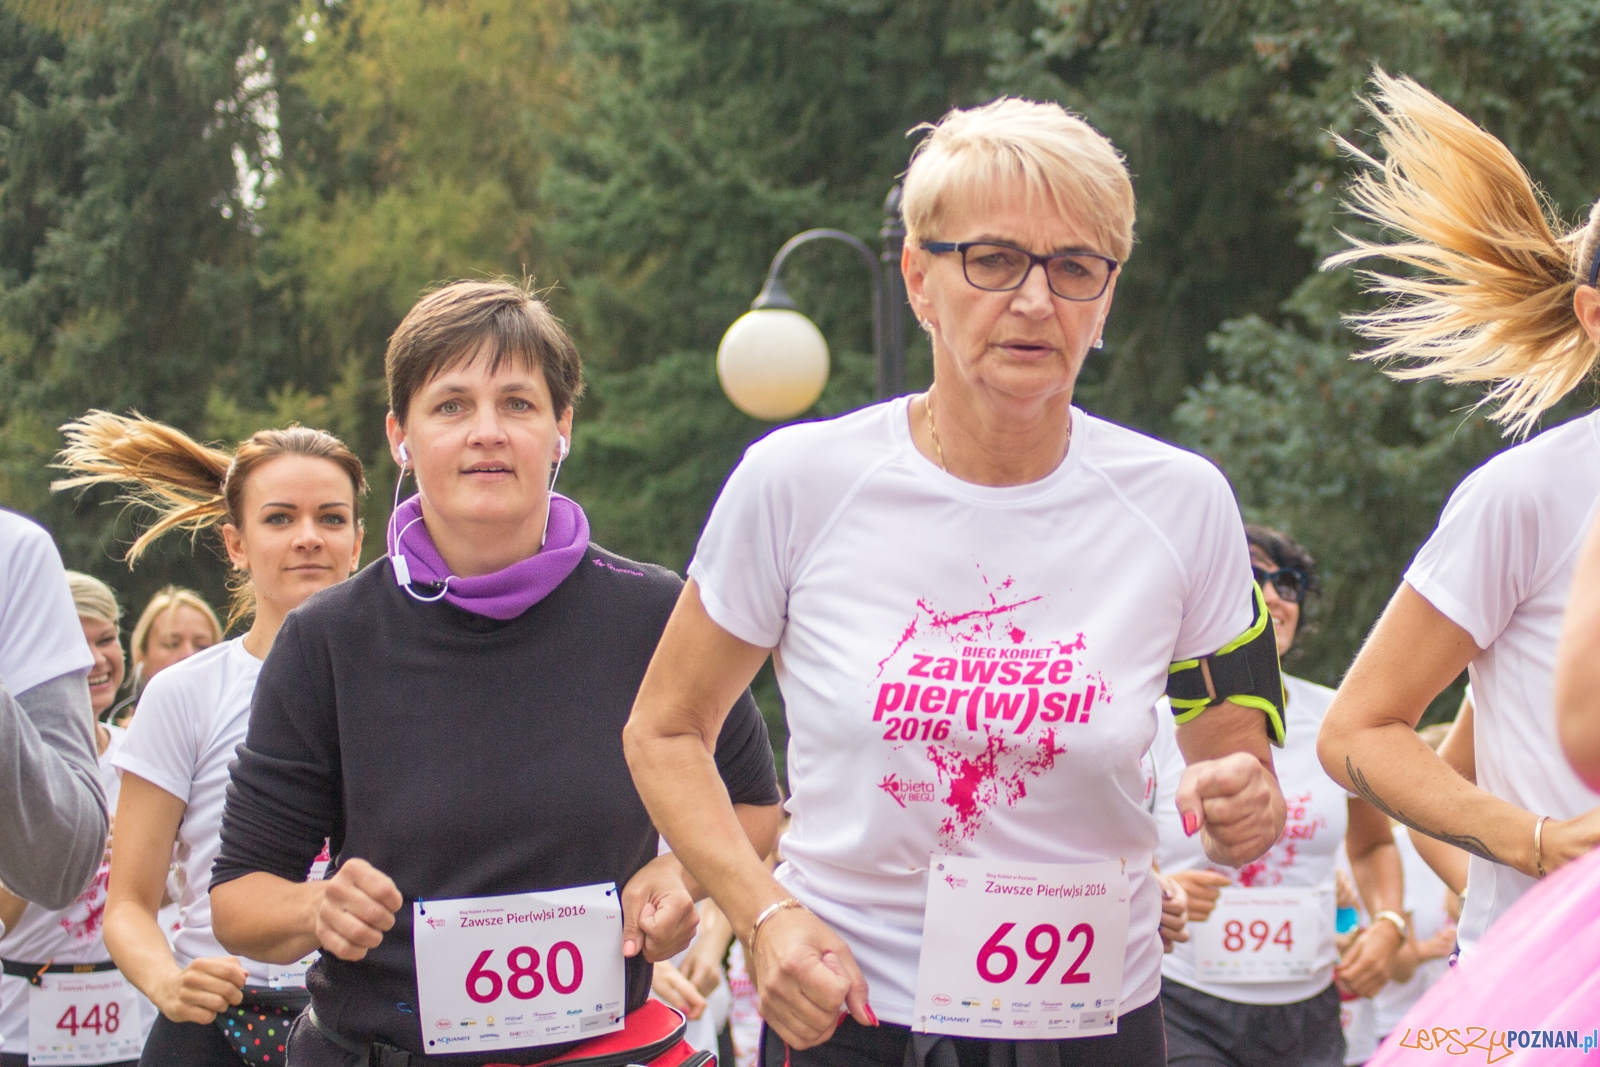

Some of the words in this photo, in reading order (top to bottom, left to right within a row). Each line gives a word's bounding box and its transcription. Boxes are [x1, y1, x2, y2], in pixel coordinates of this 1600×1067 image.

[962, 646, 997, 659] BIEG
[999, 647, 1054, 660] KOBIET
[907, 653, 1074, 685] zawsze
[872, 682, 1097, 735] pier(w)si!
[882, 717, 952, 742] 2016
[908, 793, 935, 802] BIEGU
[984, 880, 1034, 896] Zawsze
[1037, 883, 1083, 899] Pier(w)si
[1084, 883, 1107, 897] 2016
[460, 917, 504, 928] Zawsze
[506, 908, 555, 924] Pier(w)si
[557, 904, 586, 918] 2016
[1223, 920, 1294, 953] 894
[976, 922, 1095, 985] 692
[465, 940, 584, 1004] 680
[56, 1002, 120, 1037] 448
[929, 1014, 970, 1024] AQUANET
[436, 1036, 470, 1045] AQUANET
